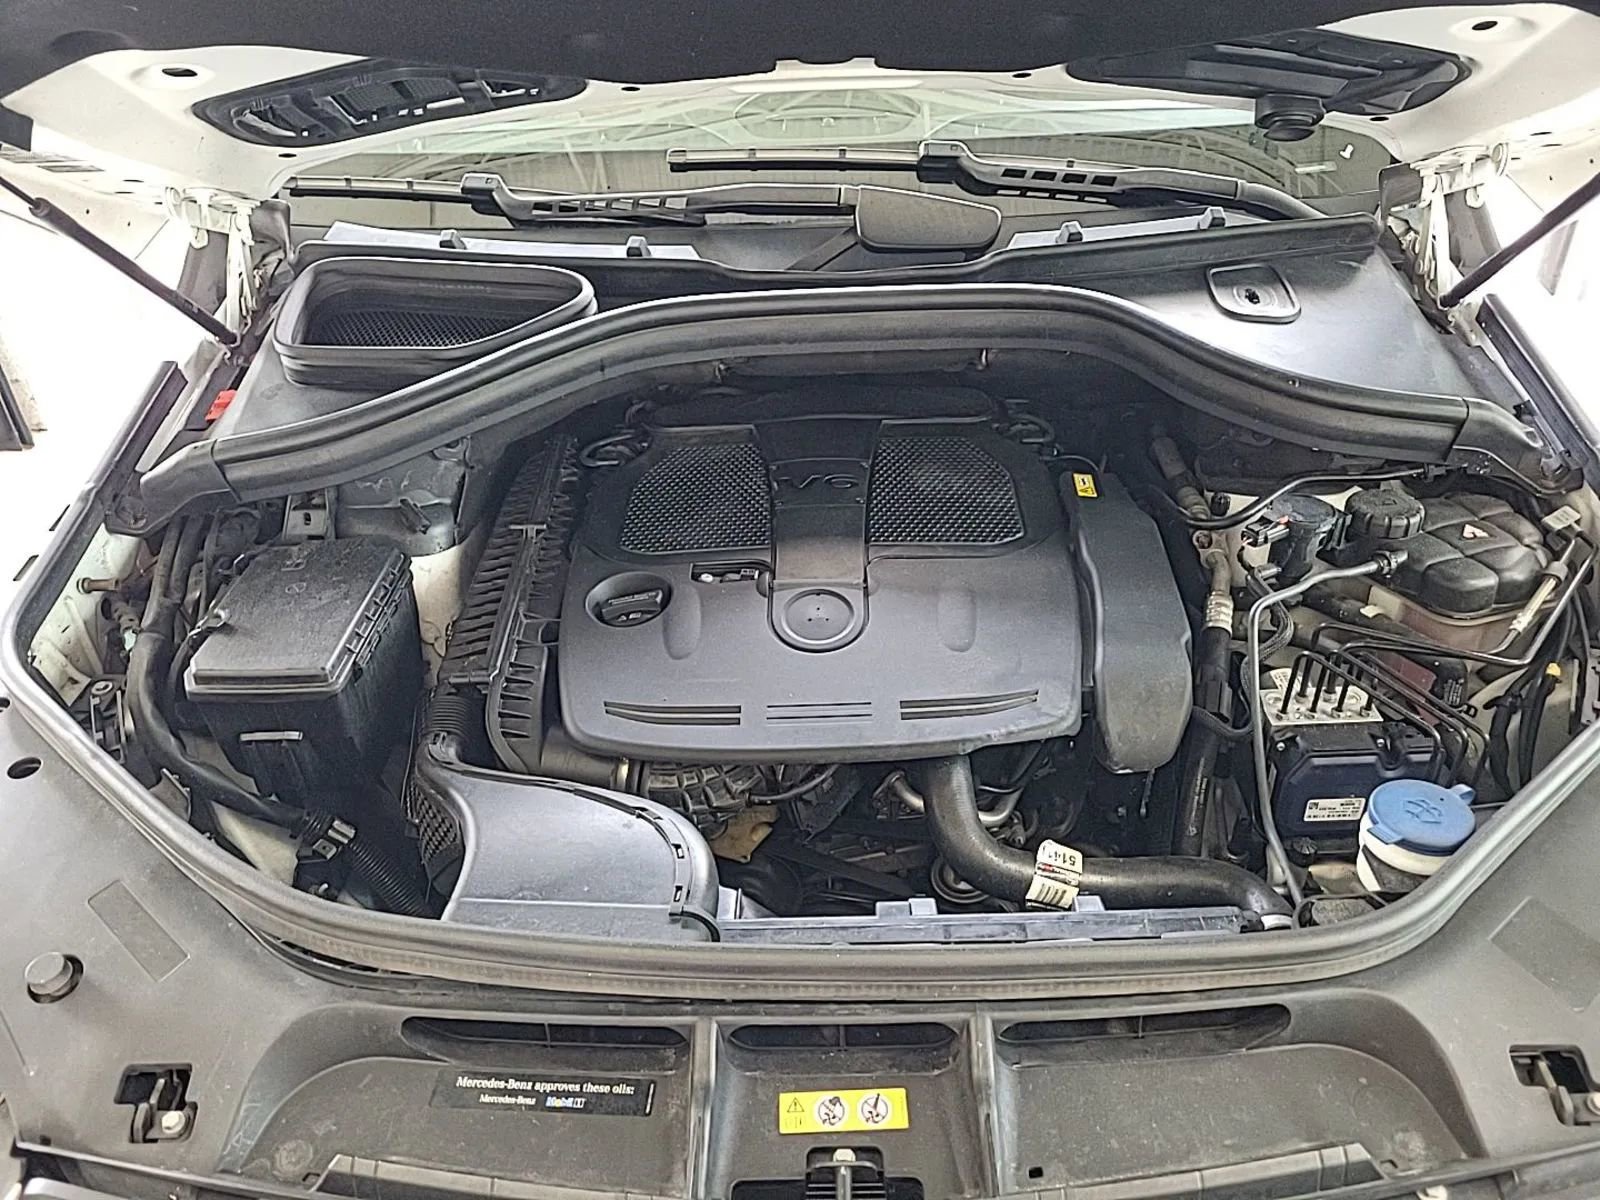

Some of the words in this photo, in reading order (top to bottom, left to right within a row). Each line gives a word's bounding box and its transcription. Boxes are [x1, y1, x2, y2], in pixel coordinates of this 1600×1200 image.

[456, 1076, 533, 1090] Mercedes-Benz
[534, 1082, 581, 1093] approves
[582, 1082, 611, 1094] these
[612, 1083, 635, 1095] oils:
[480, 1093, 536, 1105] Mercedes-Benz
